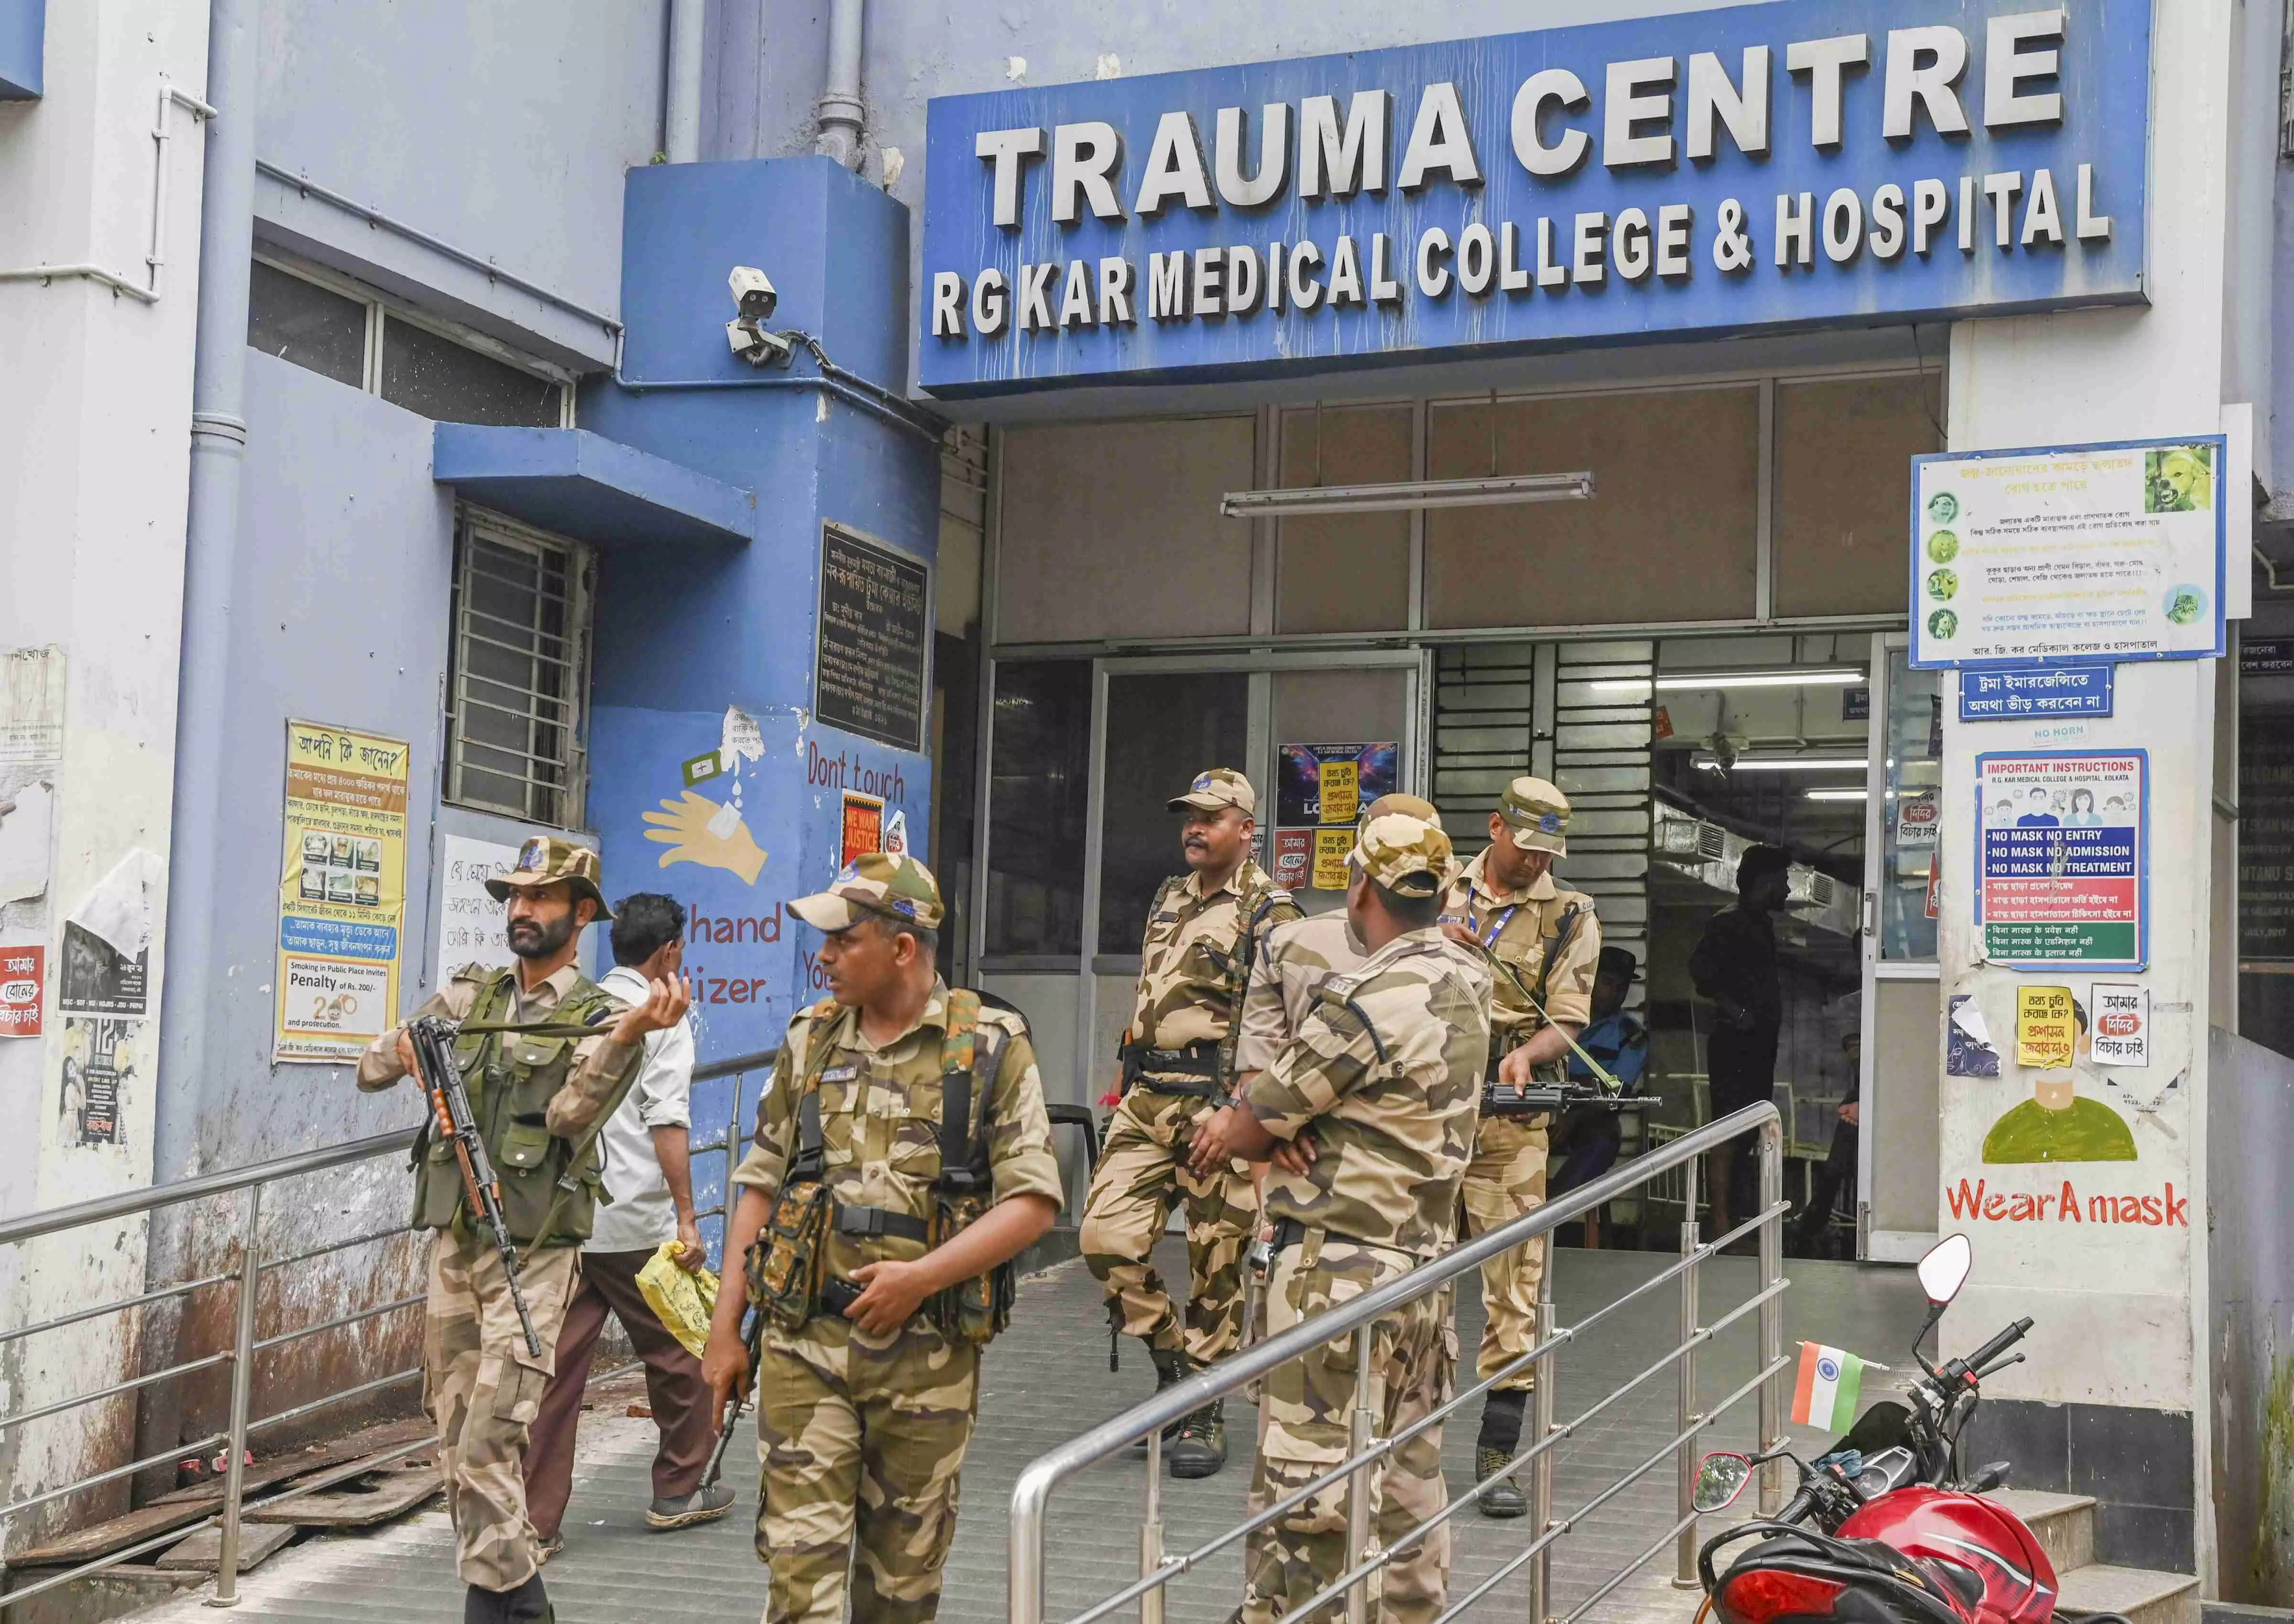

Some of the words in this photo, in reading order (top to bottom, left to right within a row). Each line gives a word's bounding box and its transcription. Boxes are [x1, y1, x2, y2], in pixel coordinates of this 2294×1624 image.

[975, 83, 1481, 230] TRAUMA
[1511, 9, 2065, 176] CENTRE
[1148, 233, 1401, 322] MEDICAL
[1418, 204, 1691, 297] COLLEGE
[1712, 198, 1753, 272] &
[1775, 163, 2110, 269] HOSPITAL
[2073, 643, 2099, 651] কলেজ
[2113, 640, 2157, 650] হাসপাতাল
[1979, 676, 2001, 692] ট্রমা
[2003, 672, 2089, 690] ইমারজেন্সিতে
[1968, 699, 2002, 712] অযথা
[2036, 697, 2082, 709] করবেন
[2086, 696, 2099, 708] না
[2054, 726, 2083, 736] HORN
[299, 733, 334, 760] আপনি
[340, 737, 352, 763] কি
[808, 741, 847, 789] Don't
[854, 754, 904, 804] touch
[1989, 764, 2049, 774] IMPORTANT
[2053, 762, 2134, 772] INSTRUCTIONS
[846, 809, 857, 827] WE
[858, 811, 879, 832] WANT
[1910, 804, 1931, 822] দিদির
[1900, 823, 1921, 839] বিচার
[1924, 824, 1937, 839] চাই
[1992, 832, 2007, 841] NO
[2011, 831, 2043, 841] MASK
[2047, 831, 2062, 840] NO
[2066, 830, 2102, 840] ENTRY
[845, 828, 877, 852] JUSTICE
[1281, 838, 1305, 850] আমার
[1992, 847, 2007, 857] NO
[2011, 847, 2043, 857] MASK
[2047, 847, 2062, 856] NO
[2066, 846, 2130, 856] ADMISSION
[1283, 855, 1304, 866] বোনের
[1992, 863, 2007, 873] NO
[2011, 863, 2043, 873] MASK
[2066, 862, 2132, 872] TREATMENT
[1277, 869, 1294, 885] বিচার
[691, 902, 781, 943] hand
[1993, 925, 2008, 934] बिना
[1993, 937, 2008, 946] बिना
[2034, 936, 2042, 945] के
[2045, 936, 2077, 946] एडमिशन
[1993, 948, 2008, 957] बिना
[2034, 948, 2042, 956] के
[2045, 949, 2066, 957] इलाज
[4, 956, 34, 976] আমার
[291, 962, 318, 972] Smoking
[328, 965, 346, 973] Public
[366, 968, 386, 977] Invites
[291, 973, 336, 991] Penalty
[359, 984, 375, 992] 200/-
[6, 983, 34, 1001] বোনের
[2029, 996, 2045, 1007] তথ্য
[2049, 994, 2064, 1010] চুরি
[2103, 995, 2137, 1012] আমার
[24, 1003, 38, 1027] চাই
[2023, 1009, 2048, 1020] করছে
[302, 1020, 341, 1029] prosecution.
[2027, 1024, 2065, 1039] প্রশাসন
[2106, 1013, 2133, 1034] দিদির
[2096, 1037, 2122, 1057] বিচার
[2125, 1037, 2144, 1057] চাই
[1947, 1178, 2056, 1221] Wear
[2059, 1181, 2081, 1223] A
[2089, 1182, 2188, 1227] mask
